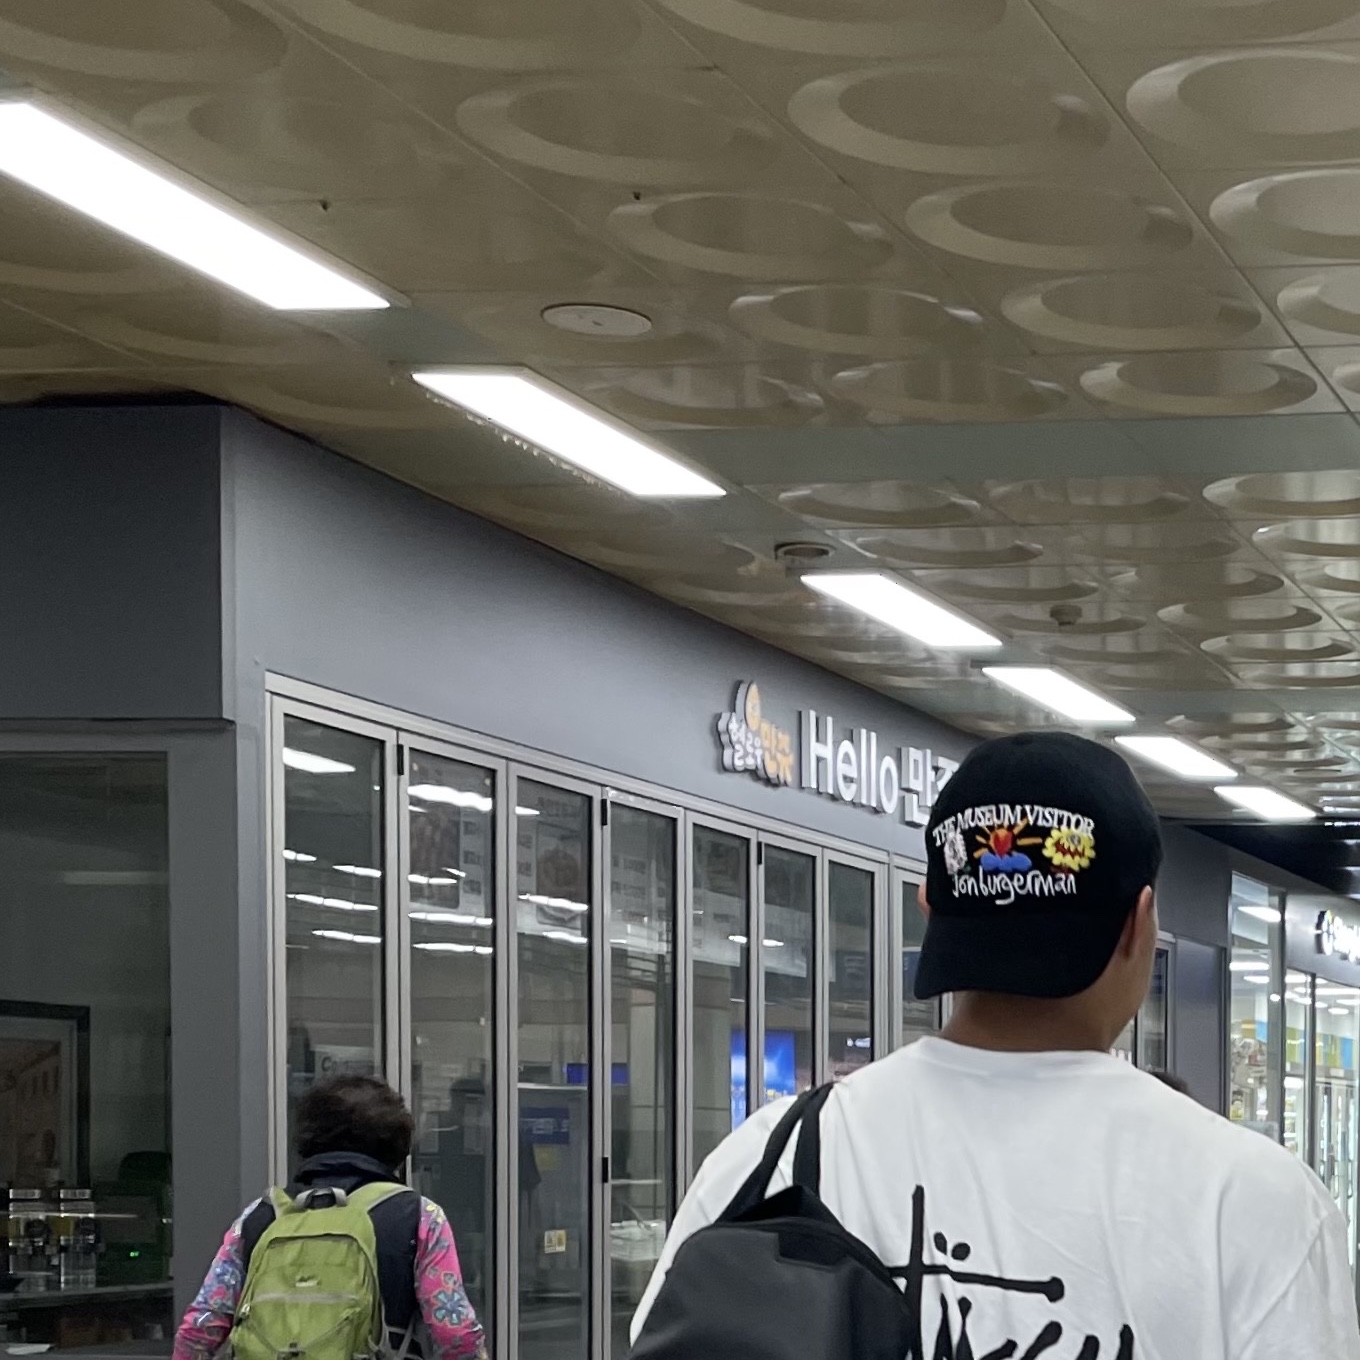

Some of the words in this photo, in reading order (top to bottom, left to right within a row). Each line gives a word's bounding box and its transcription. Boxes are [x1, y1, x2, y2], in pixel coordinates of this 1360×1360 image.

[808, 709, 899, 814] Hello
[931, 815, 957, 848] THE
[956, 803, 1023, 831] MUSEUM
[1023, 804, 1096, 841] VISITOR
